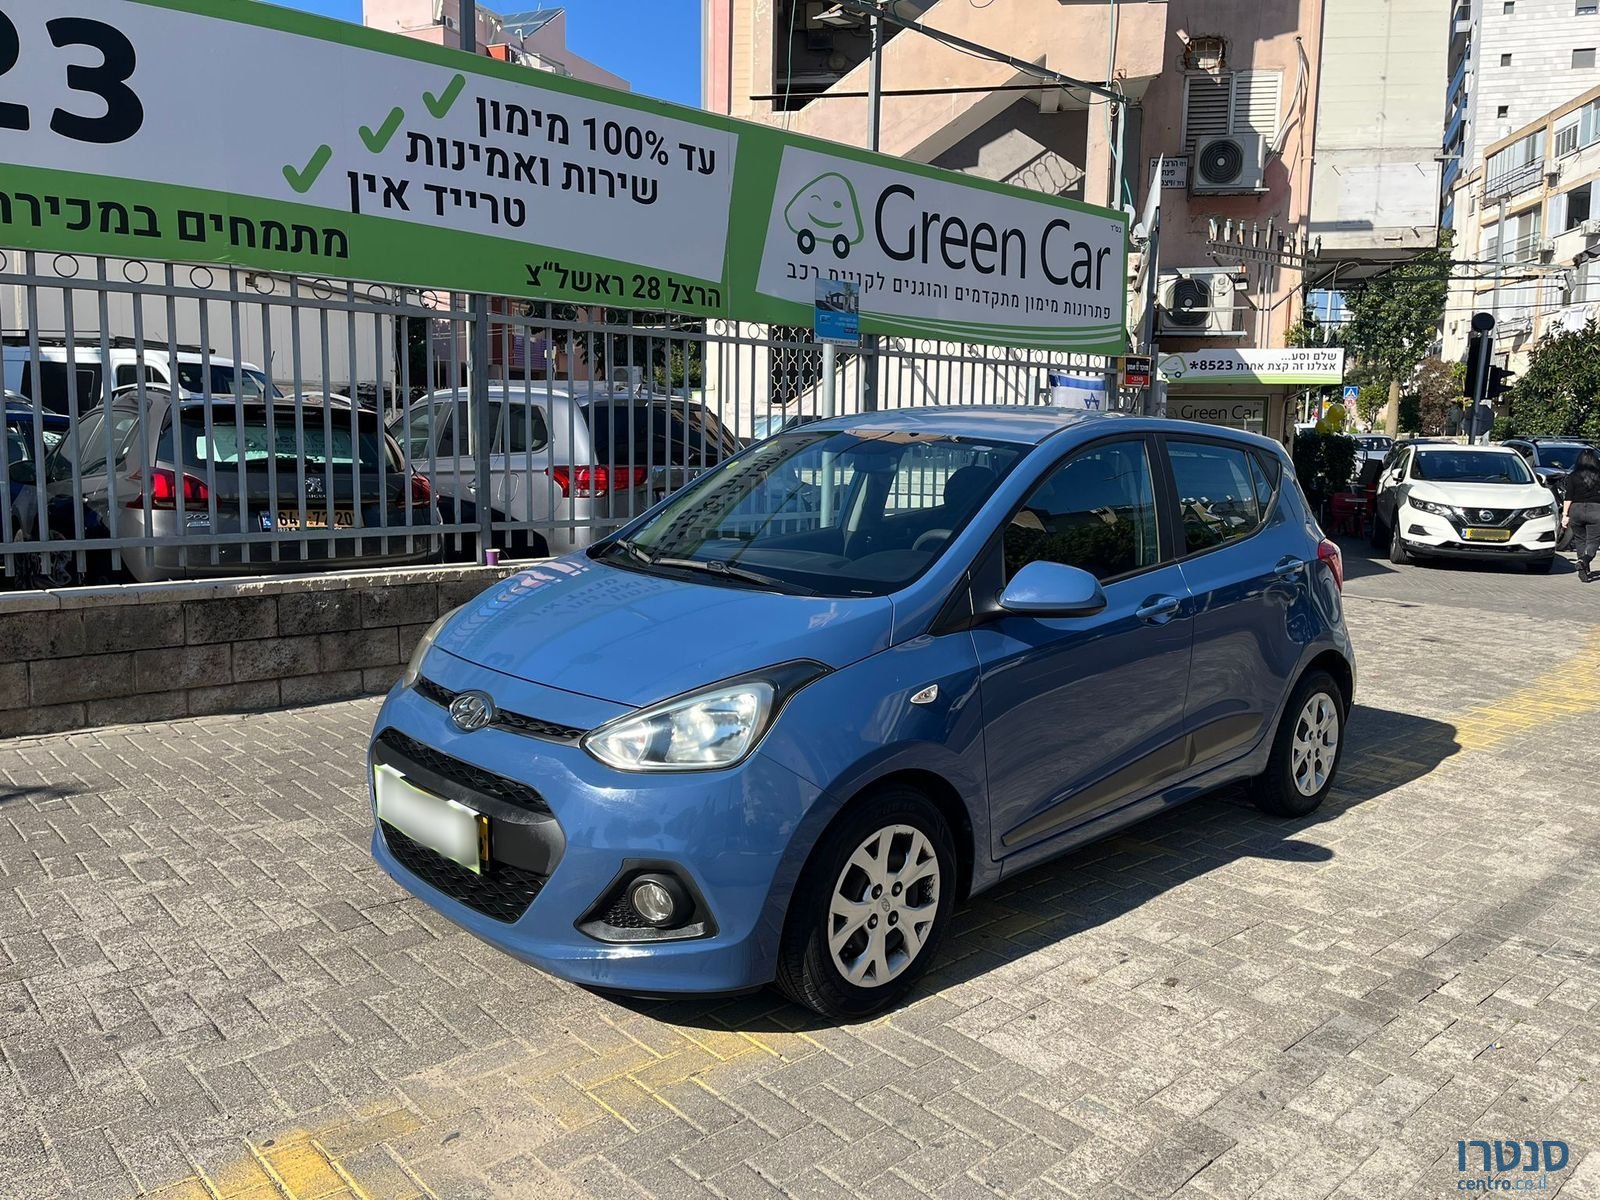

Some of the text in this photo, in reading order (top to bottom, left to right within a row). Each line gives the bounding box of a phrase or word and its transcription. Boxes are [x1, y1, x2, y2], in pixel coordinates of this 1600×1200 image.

[476, 96, 716, 175] עד 100% מימון
[405, 131, 658, 205] שירות ואמינות
[346, 170, 527, 228] טרייד אין
[177, 209, 349, 259] מתמחים
[874, 183, 1111, 291] Green Car
[787, 262, 820, 280] רכב
[524, 260, 721, 308] הרצל 28 ראשל"צ
[893, 277, 948, 299] והוגנים
[955, 286, 1019, 309] מתקדמים
[1025, 295, 1059, 313] מימון
[1063, 301, 1111, 320] פתרונות
[1236, 360, 1336, 373] אצלנו זה קצת אחרת
[1313, 351, 1338, 361] שלם
[1181, 404, 1259, 420] Green Car
